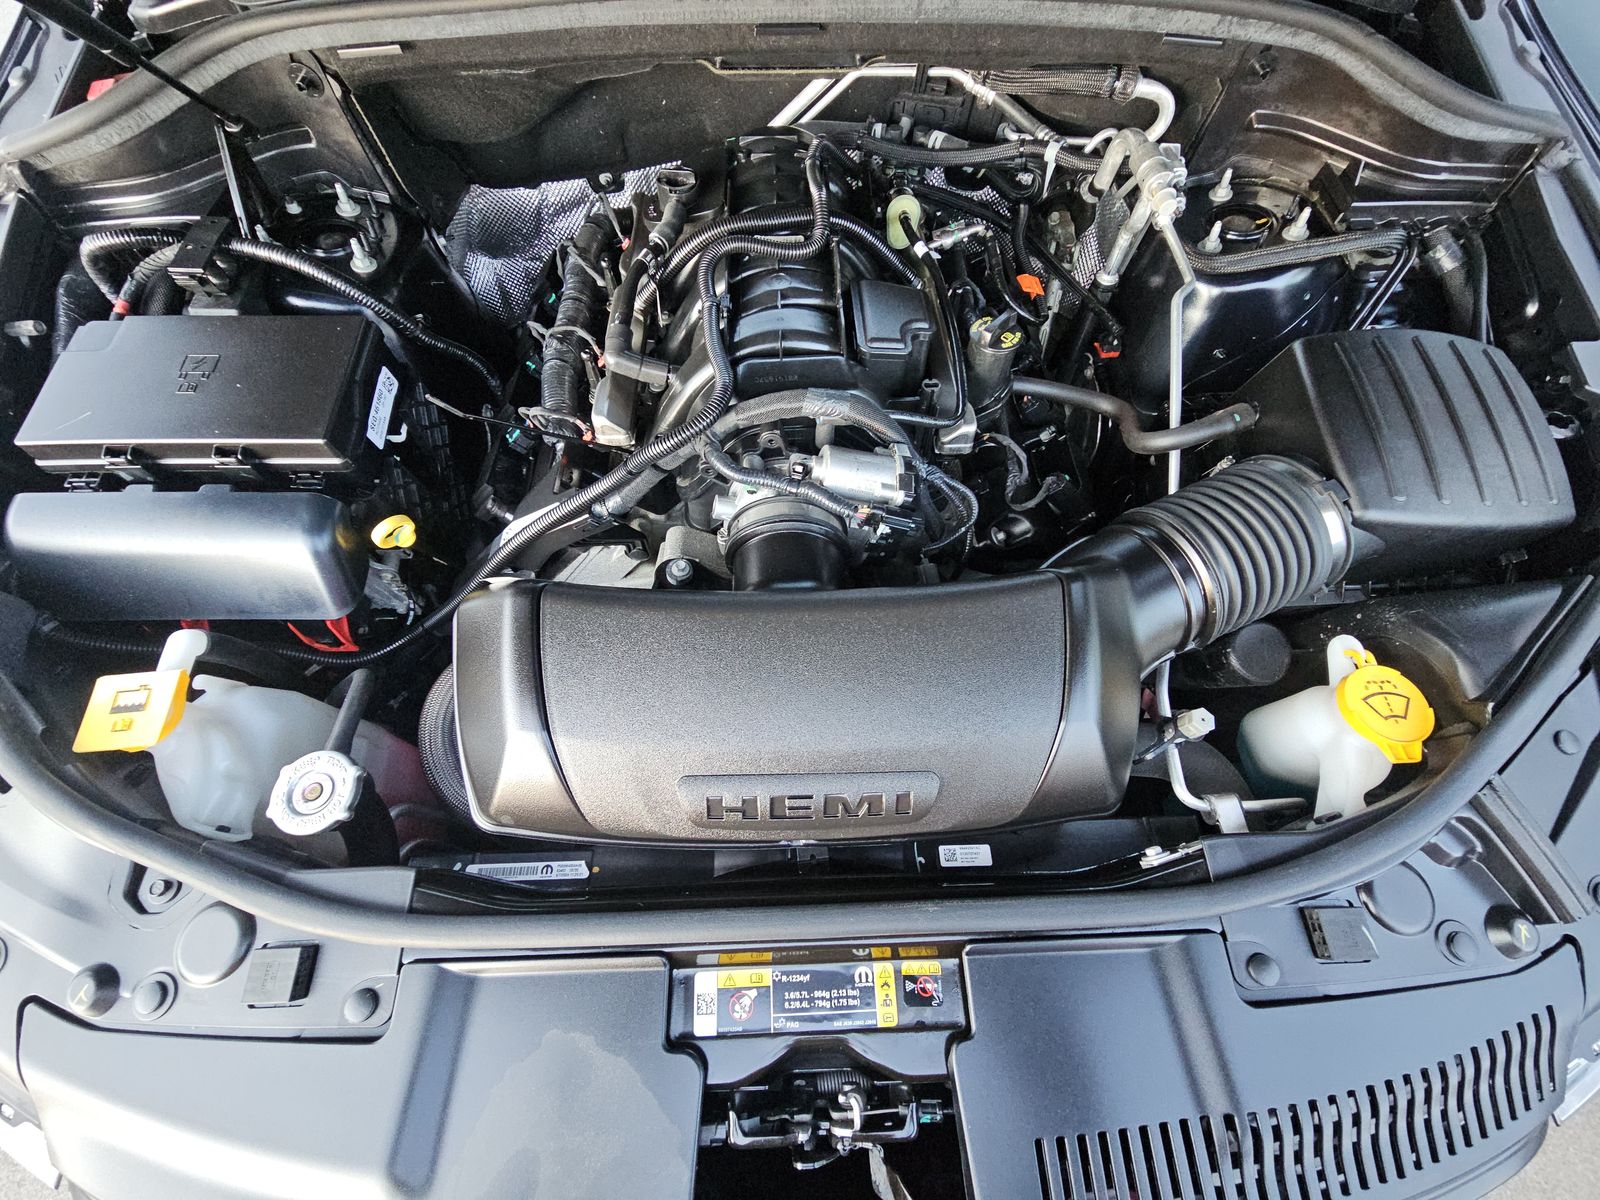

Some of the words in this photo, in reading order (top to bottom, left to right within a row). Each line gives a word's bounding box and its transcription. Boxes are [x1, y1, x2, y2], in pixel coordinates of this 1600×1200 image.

[706, 791, 914, 820] HEMI
[781, 974, 811, 982] R-1234yf
[784, 991, 809, 1000] 3.6/5.7L
[831, 989, 847, 998] (2.13
[847, 988, 860, 998] lbs)
[814, 1000, 830, 1008] 794g
[831, 999, 847, 1008] (1.75
[847, 998, 860, 1007] lbs)
